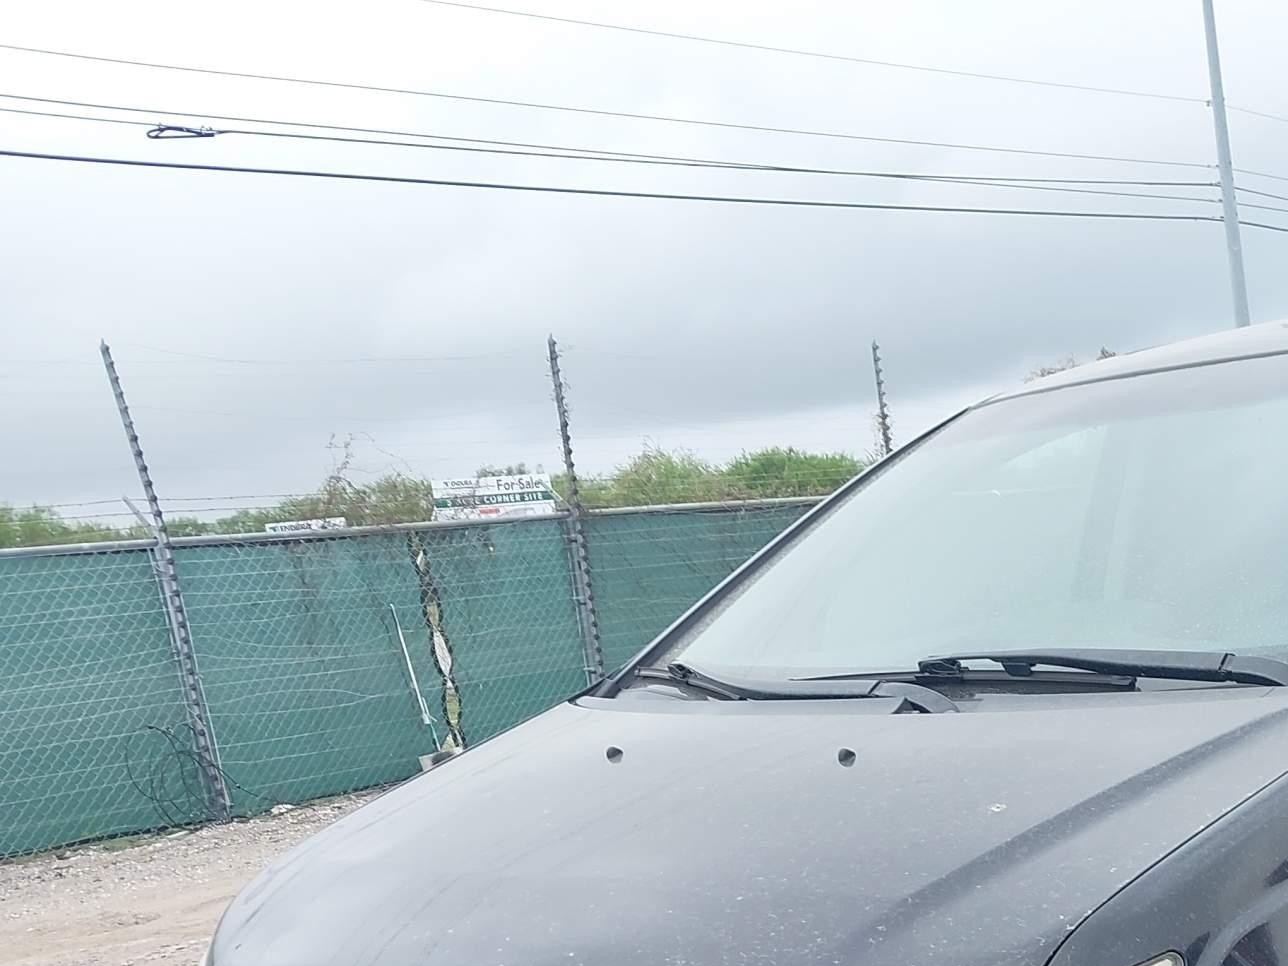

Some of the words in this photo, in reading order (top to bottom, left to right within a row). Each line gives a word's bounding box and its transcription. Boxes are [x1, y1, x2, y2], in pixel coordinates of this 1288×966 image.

[496, 479, 514, 491] For
[519, 477, 541, 490] Sale
[484, 493, 521, 504] CORNER
